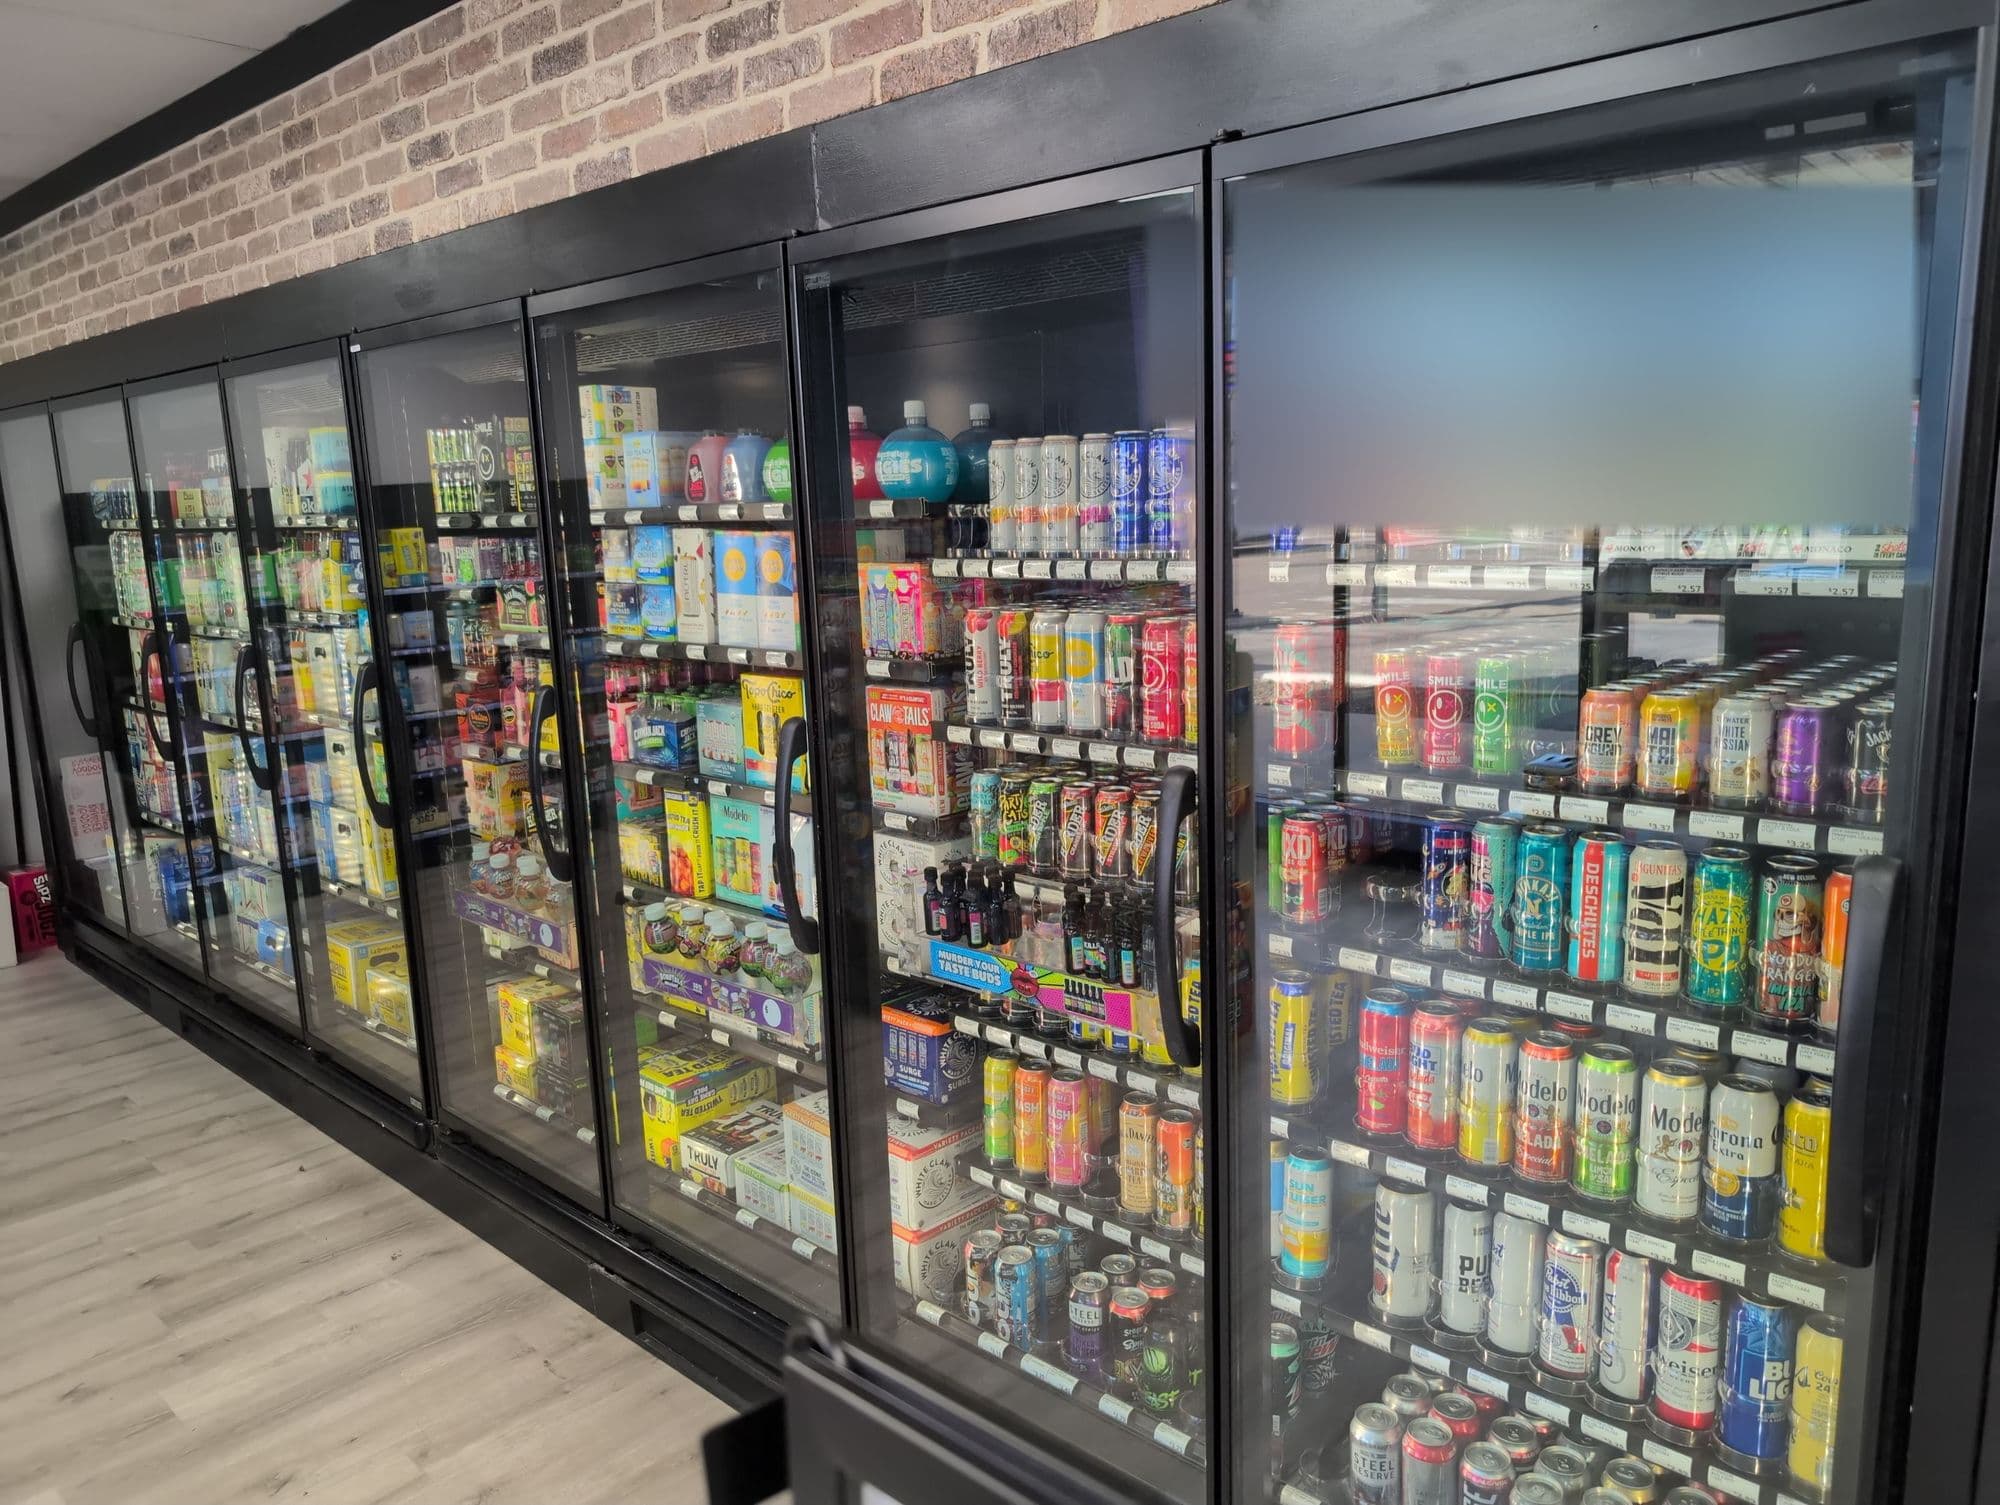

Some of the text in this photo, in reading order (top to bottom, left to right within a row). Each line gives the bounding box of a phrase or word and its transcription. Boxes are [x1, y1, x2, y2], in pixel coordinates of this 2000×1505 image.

[1678, 585, 1701, 593] $2.57
[1764, 586, 1789, 596] $2.57
[1828, 587, 1855, 596] $2.57
[1428, 675, 1465, 686] SMILE
[870, 703, 930, 727] CLAW TAILS
[1585, 725, 1622, 743] GREY
[1648, 725, 1676, 745] MAI
[1719, 724, 1746, 739] WHITE
[723, 806, 749, 822] Modelo
[1716, 831, 1740, 840] $3.37
[1582, 863, 1600, 960] DESCHUTES
[1716, 926, 1745, 937] THING
[938, 950, 1001, 976] MURDER YOUR
[938, 959, 1002, 985] TASTE BUDS
[940, 1036, 954, 1069] WHITE
[899, 1064, 922, 1078] SURGE
[1650, 1103, 1703, 1134] Mode
[687, 1145, 719, 1171] TRULY
[915, 1157, 951, 1199] WHITE CLAW
[1289, 1178, 1315, 1191] SUN
[921, 1240, 958, 1281] WHITE CLAW
[1459, 1255, 1491, 1276] PU
[1546, 1267, 1571, 1290] Pabst
[1764, 1361, 1791, 1382] BU
[1750, 1377, 1793, 1401] LIG
[1816, 1383, 1831, 1394] 24
[1353, 1451, 1396, 1472] STEEL
